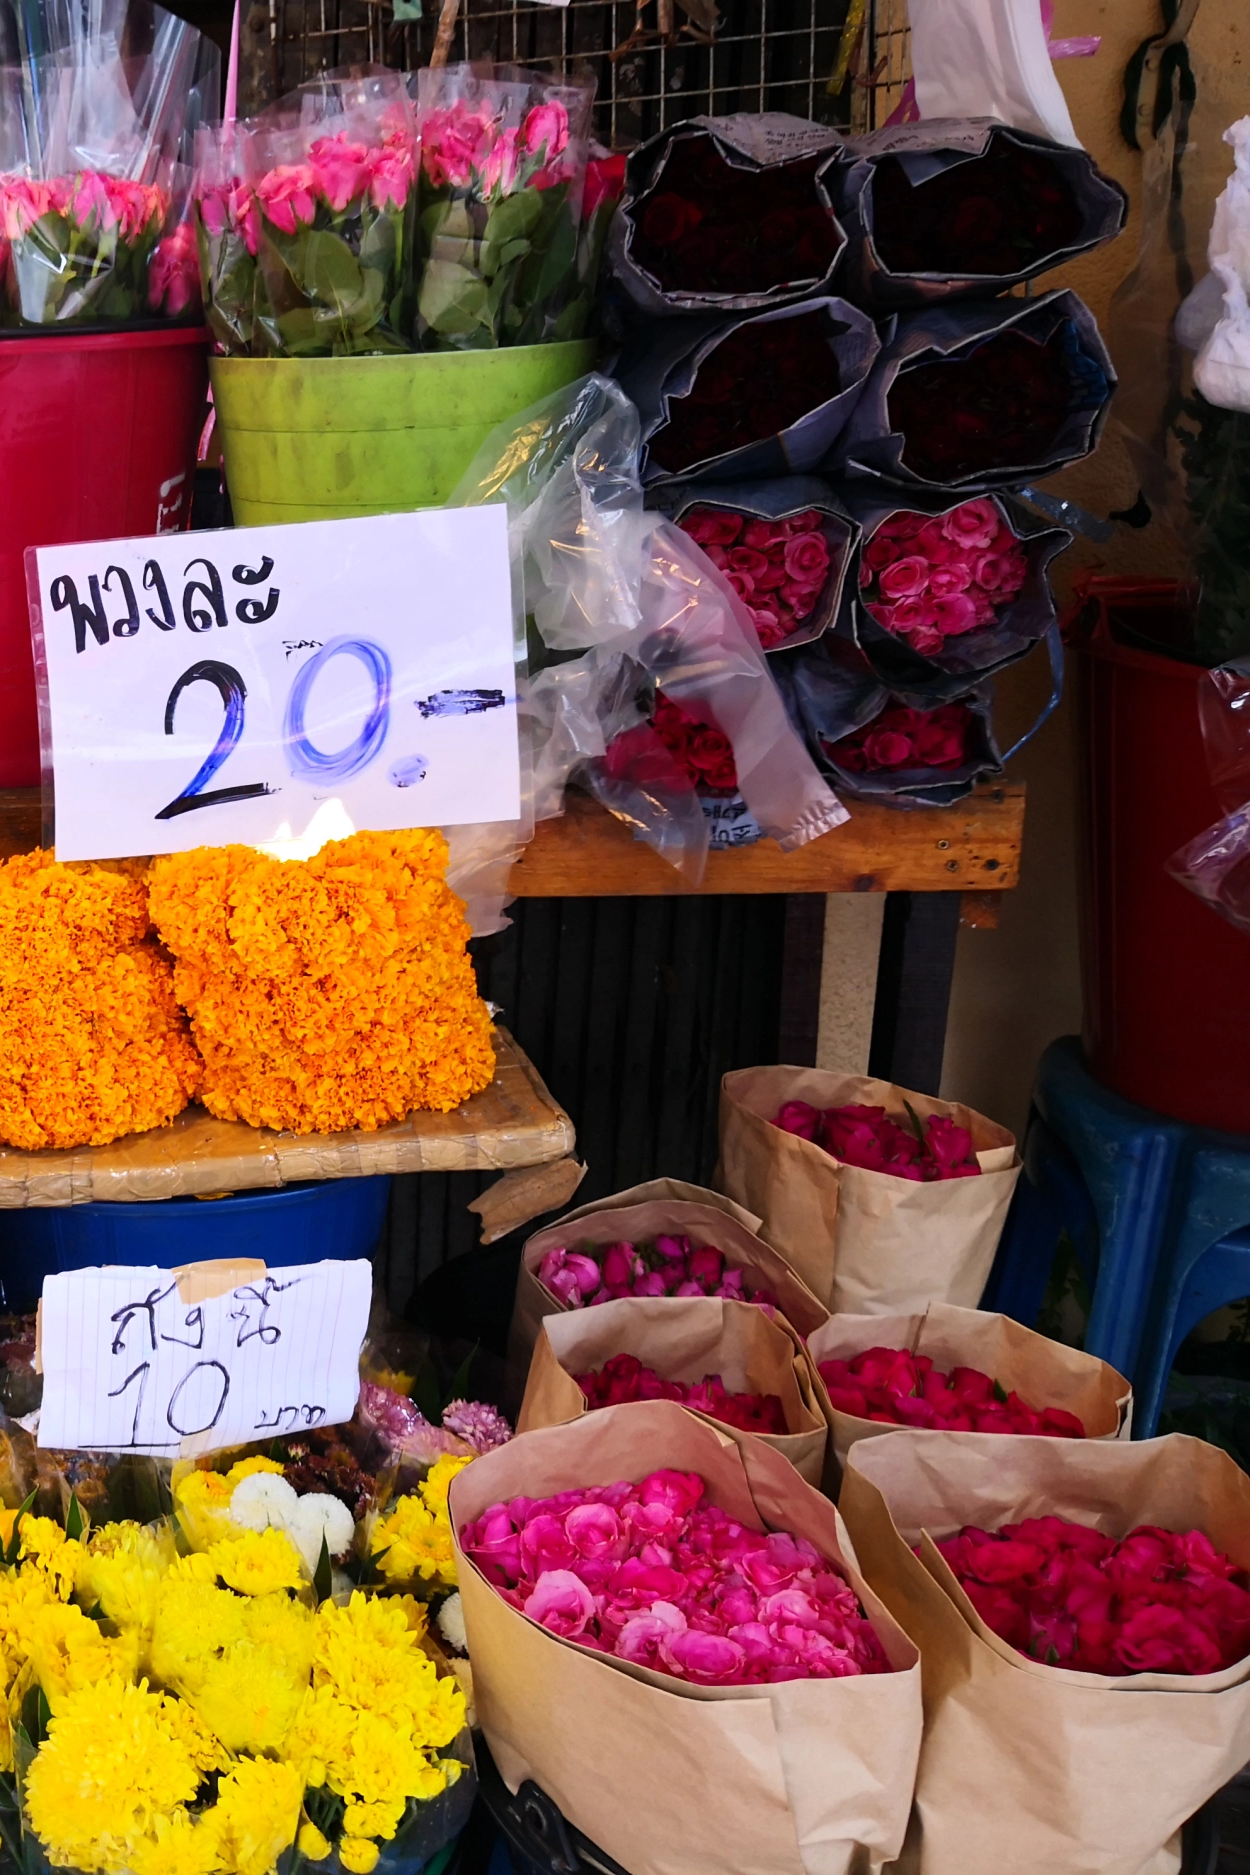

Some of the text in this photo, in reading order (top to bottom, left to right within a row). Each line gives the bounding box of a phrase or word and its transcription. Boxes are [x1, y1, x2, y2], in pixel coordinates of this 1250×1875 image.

[50, 554, 280, 654] พวงละ
[78, 1360, 326, 1448] 10 บาท
